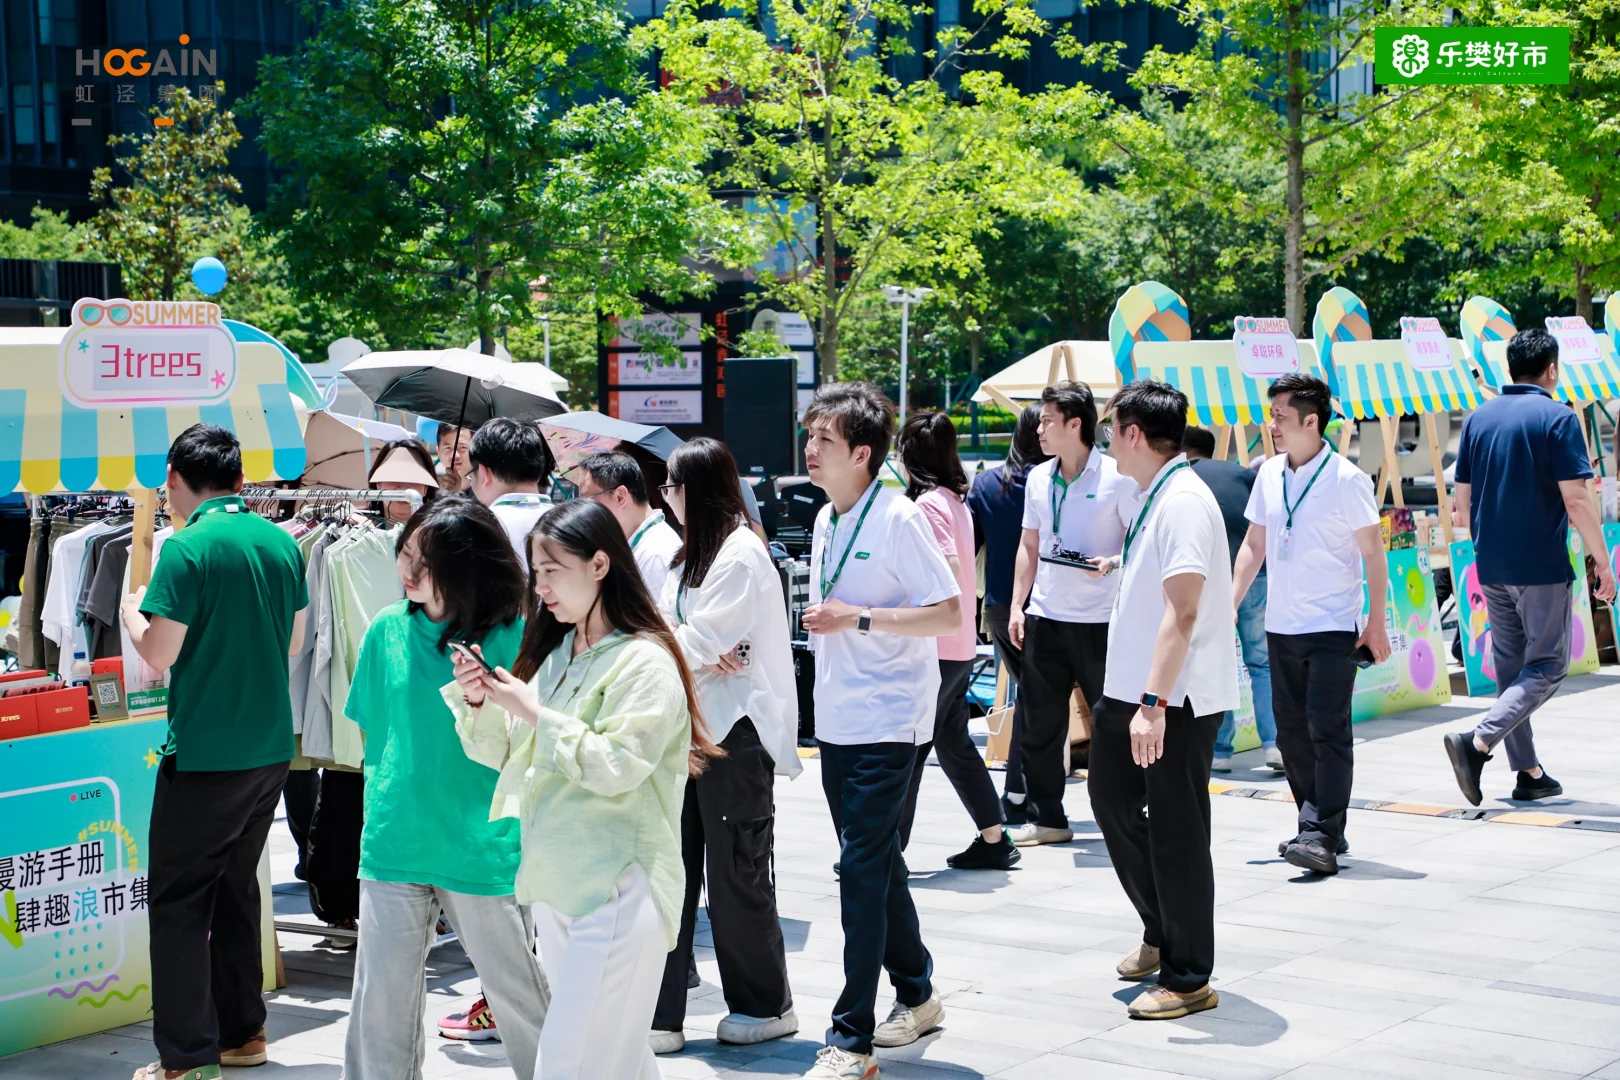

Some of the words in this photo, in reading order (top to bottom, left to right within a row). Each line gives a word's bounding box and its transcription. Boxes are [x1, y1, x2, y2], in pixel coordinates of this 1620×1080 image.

[133, 303, 219, 325] SUMMER
[1255, 319, 1289, 332] SUMMER
[101, 344, 202, 378] 3trees
[80, 790, 101, 800] LIVE
[78, 820, 139, 872] #SUMMER
[15, 876, 150, 933] 肆趣浪市集
